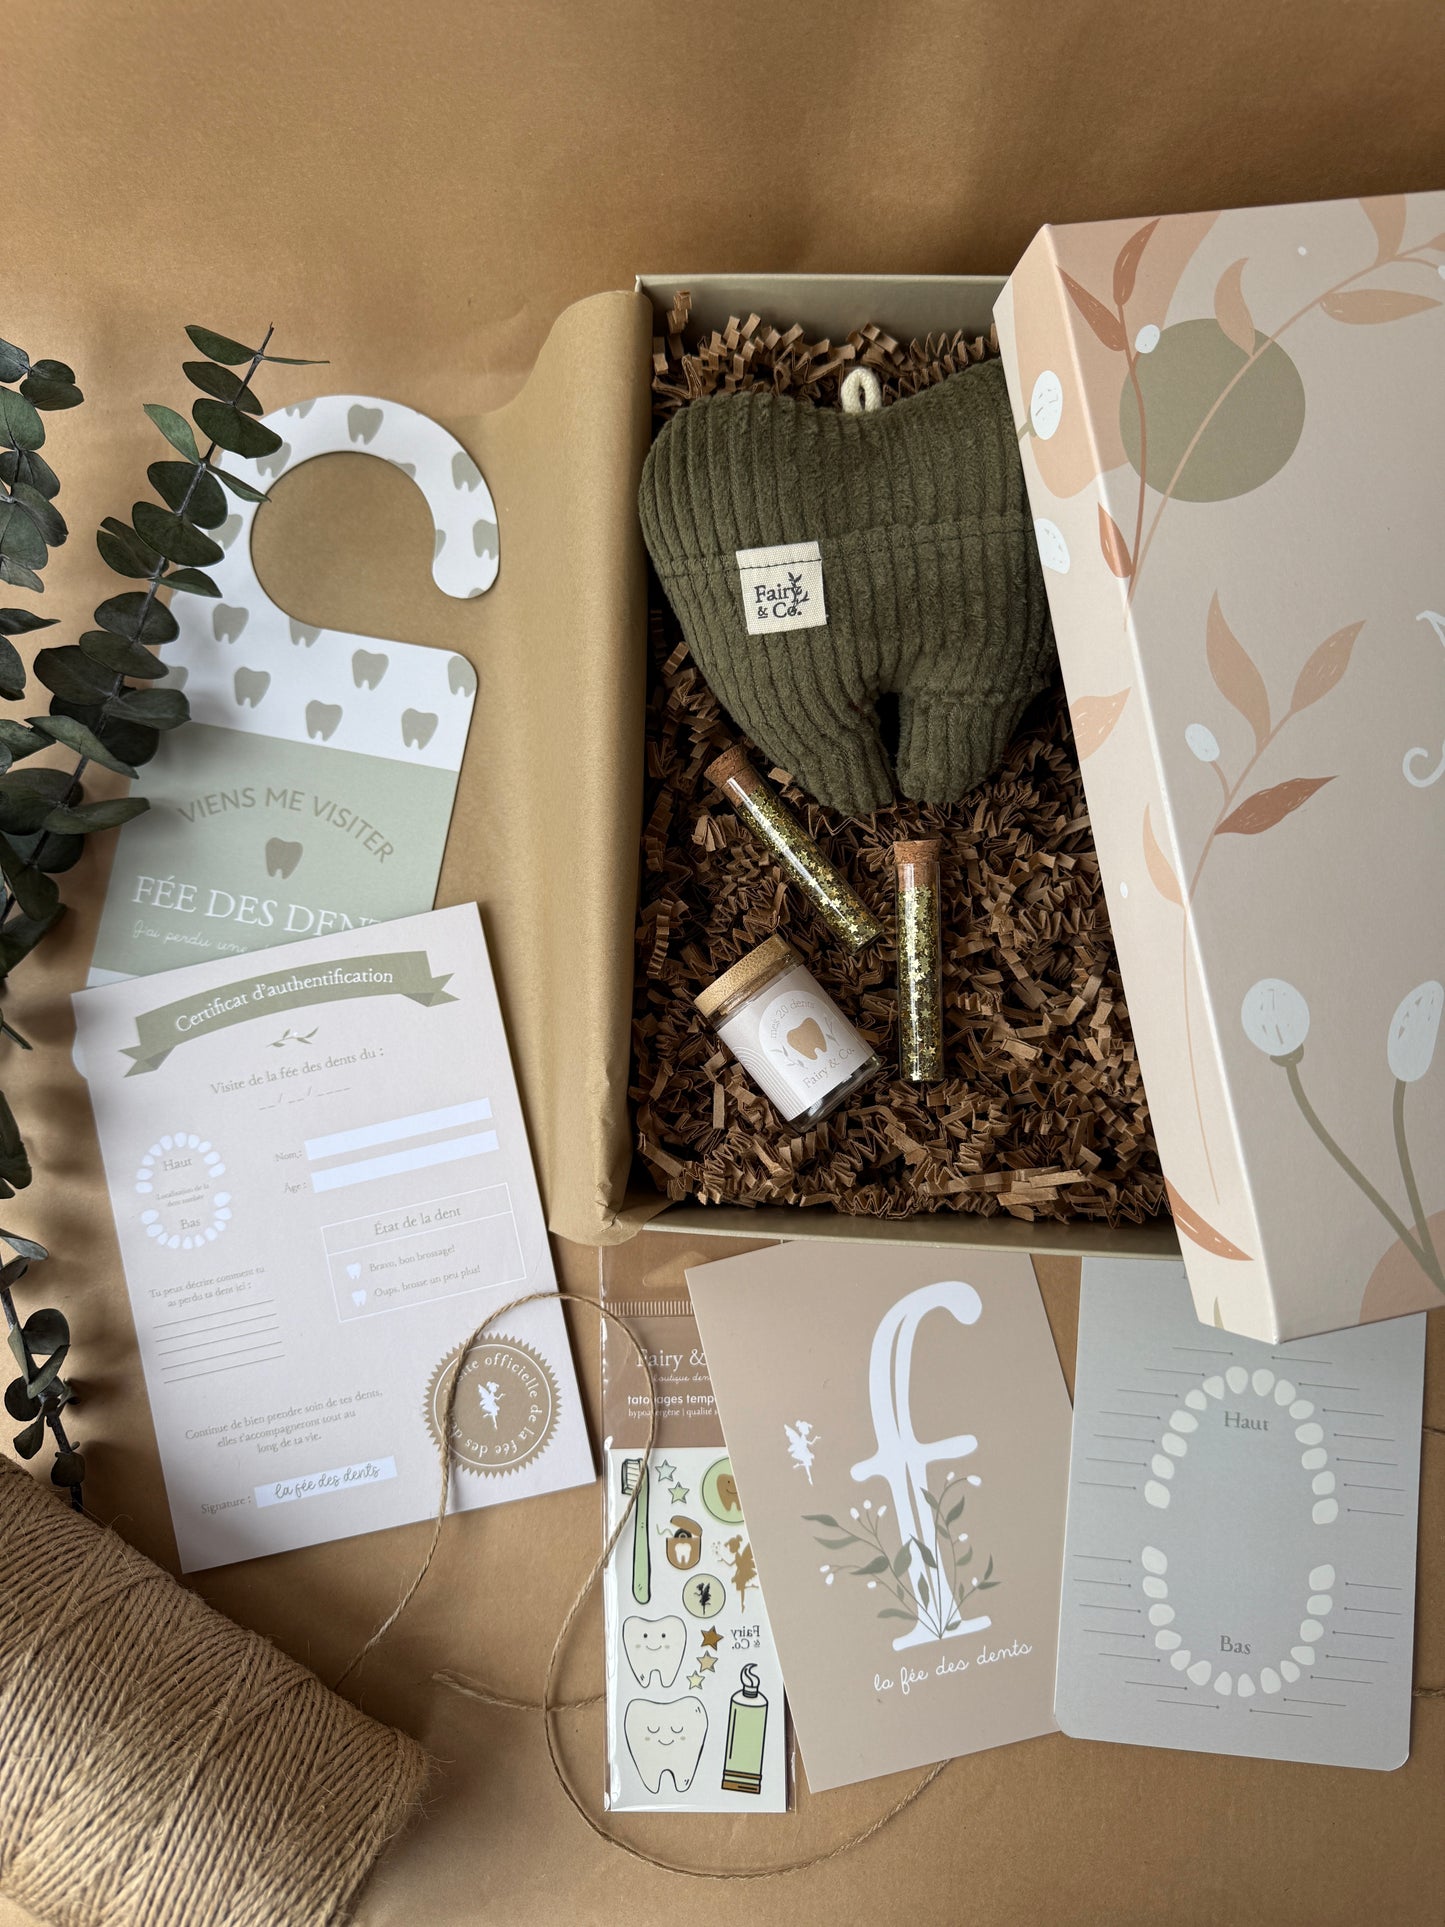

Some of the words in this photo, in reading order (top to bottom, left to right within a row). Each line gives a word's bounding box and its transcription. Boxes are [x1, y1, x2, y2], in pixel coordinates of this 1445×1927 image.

[754, 583, 801, 603] Fairy
[757, 606, 768, 619] &
[772, 602, 802, 618] Co.
[177, 787, 256, 823] VIENS
[265, 787, 305, 812] ME
[313, 796, 394, 863] VISITER
[132, 875, 198, 913] FÉE
[205, 889, 278, 927] DES
[284, 904, 381, 936] DEN
[163, 932, 211, 947] perdu
[217, 942, 249, 953] une
[175, 993, 248, 1032] Certificat
[252, 968, 394, 1001] d'authentification
[775, 1004, 789, 1018] 20
[209, 1080, 245, 1094] Visite
[248, 1073, 264, 1087] de
[266, 1071, 277, 1082] la
[280, 1067, 298, 1081] fée
[302, 1061, 322, 1074] des
[325, 1055, 356, 1069] dents
[359, 1048, 376, 1061] du
[802, 1067, 828, 1088] Fairy
[829, 1059, 840, 1068] &
[838, 1048, 855, 1060] Co.
[163, 1158, 192, 1171] Haut
[274, 1152, 297, 1162] Nom
[180, 1217, 200, 1230] Bas
[374, 1219, 400, 1235] État
[403, 1215, 418, 1228] de
[420, 1212, 432, 1225] la
[435, 1207, 462, 1221] dent
[399, 1254, 415, 1265] bon
[416, 1244, 456, 1261] brossage!
[149, 1289, 161, 1298] Tu
[163, 1286, 184, 1298] peux
[185, 1277, 214, 1290] décrire
[215, 1269, 254, 1283] comment
[402, 1279, 428, 1291] brosse
[430, 1276, 441, 1284] un
[443, 1272, 459, 1284] peu
[460, 1265, 480, 1279] plus!
[179, 1292, 203, 1308] perdu
[215, 1287, 233, 1297] dent
[235, 1282, 246, 1292] ici
[690, 1348, 706, 1365] &
[485, 1353, 539, 1398] officielle
[687, 1394, 717, 1406] temp
[185, 1424, 228, 1440] Continue
[230, 1419, 242, 1430] de
[243, 1417, 264, 1429] bien
[266, 1406, 302, 1424] prendre
[304, 1402, 323, 1413] soin
[326, 1397, 338, 1408] de
[340, 1395, 352, 1404] tes
[528, 1404, 542, 1422] de
[628, 1407, 680, 1419] hypoaergène
[687, 1406, 712, 1418] qualité
[1224, 1410, 1269, 1431] Haut
[217, 1435, 237, 1448] elles
[239, 1418, 320, 1442] t'accompagneront
[322, 1412, 342, 1423] tout
[344, 1410, 356, 1418] au
[518, 1427, 535, 1440] la
[257, 1443, 278, 1455] long
[280, 1437, 292, 1448] de
[293, 1435, 303, 1445] ta
[305, 1431, 322, 1442] vie.
[465, 1439, 488, 1458] des
[495, 1440, 518, 1455] fée
[201, 1497, 245, 1515] Signature
[274, 1483, 293, 1499] la
[295, 1477, 317, 1498] fée
[318, 1472, 341, 1488] des
[343, 1463, 380, 1482] dents
[1220, 1635, 1251, 1655] Bas
[874, 1674, 894, 1692] la
[900, 1666, 929, 1695] fée
[935, 1656, 969, 1676] des
[976, 1639, 1032, 1665] dents
